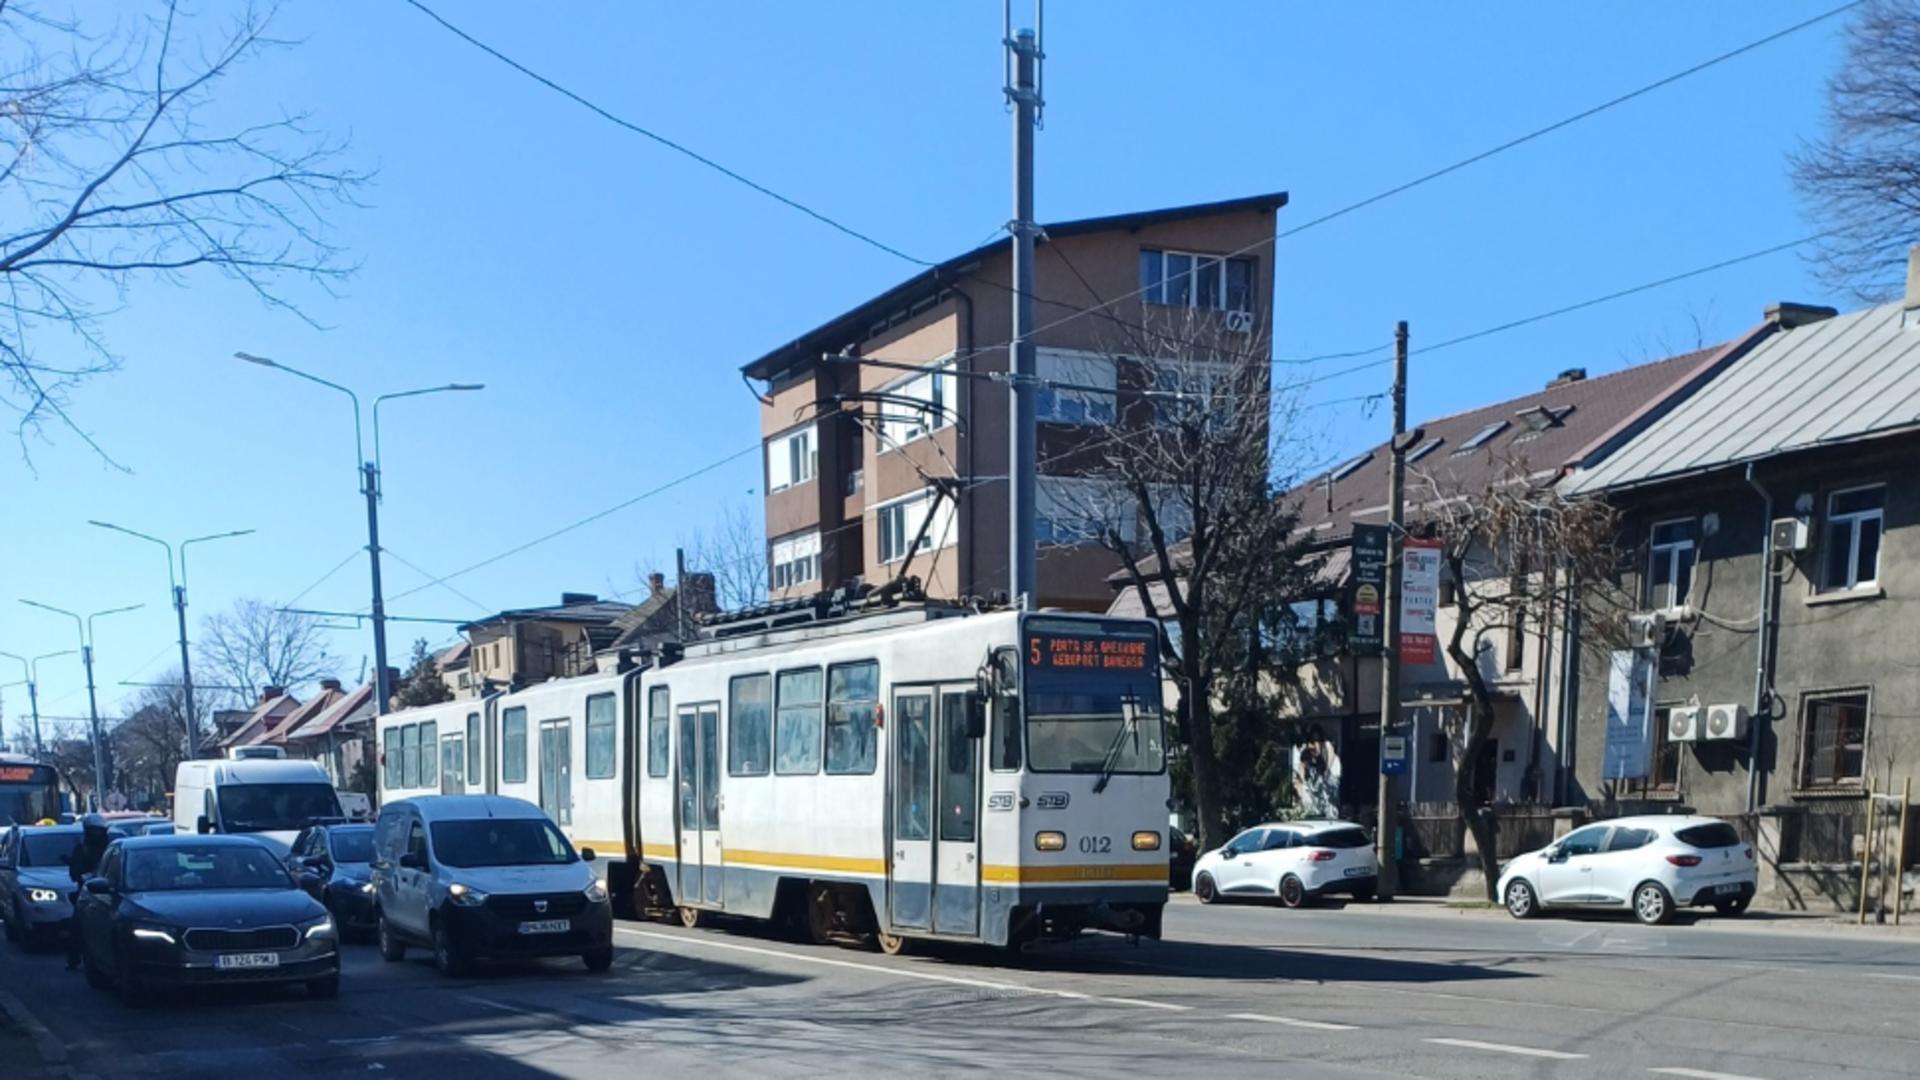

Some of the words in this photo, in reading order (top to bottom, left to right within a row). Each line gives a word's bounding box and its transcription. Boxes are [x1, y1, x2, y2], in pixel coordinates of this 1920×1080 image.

[1030, 638, 1041, 665] 5
[1052, 653, 1099, 667] AEROPORT
[988, 795, 1014, 808] STB
[1037, 795, 1067, 808] STB
[1079, 836, 1111, 853] 012
